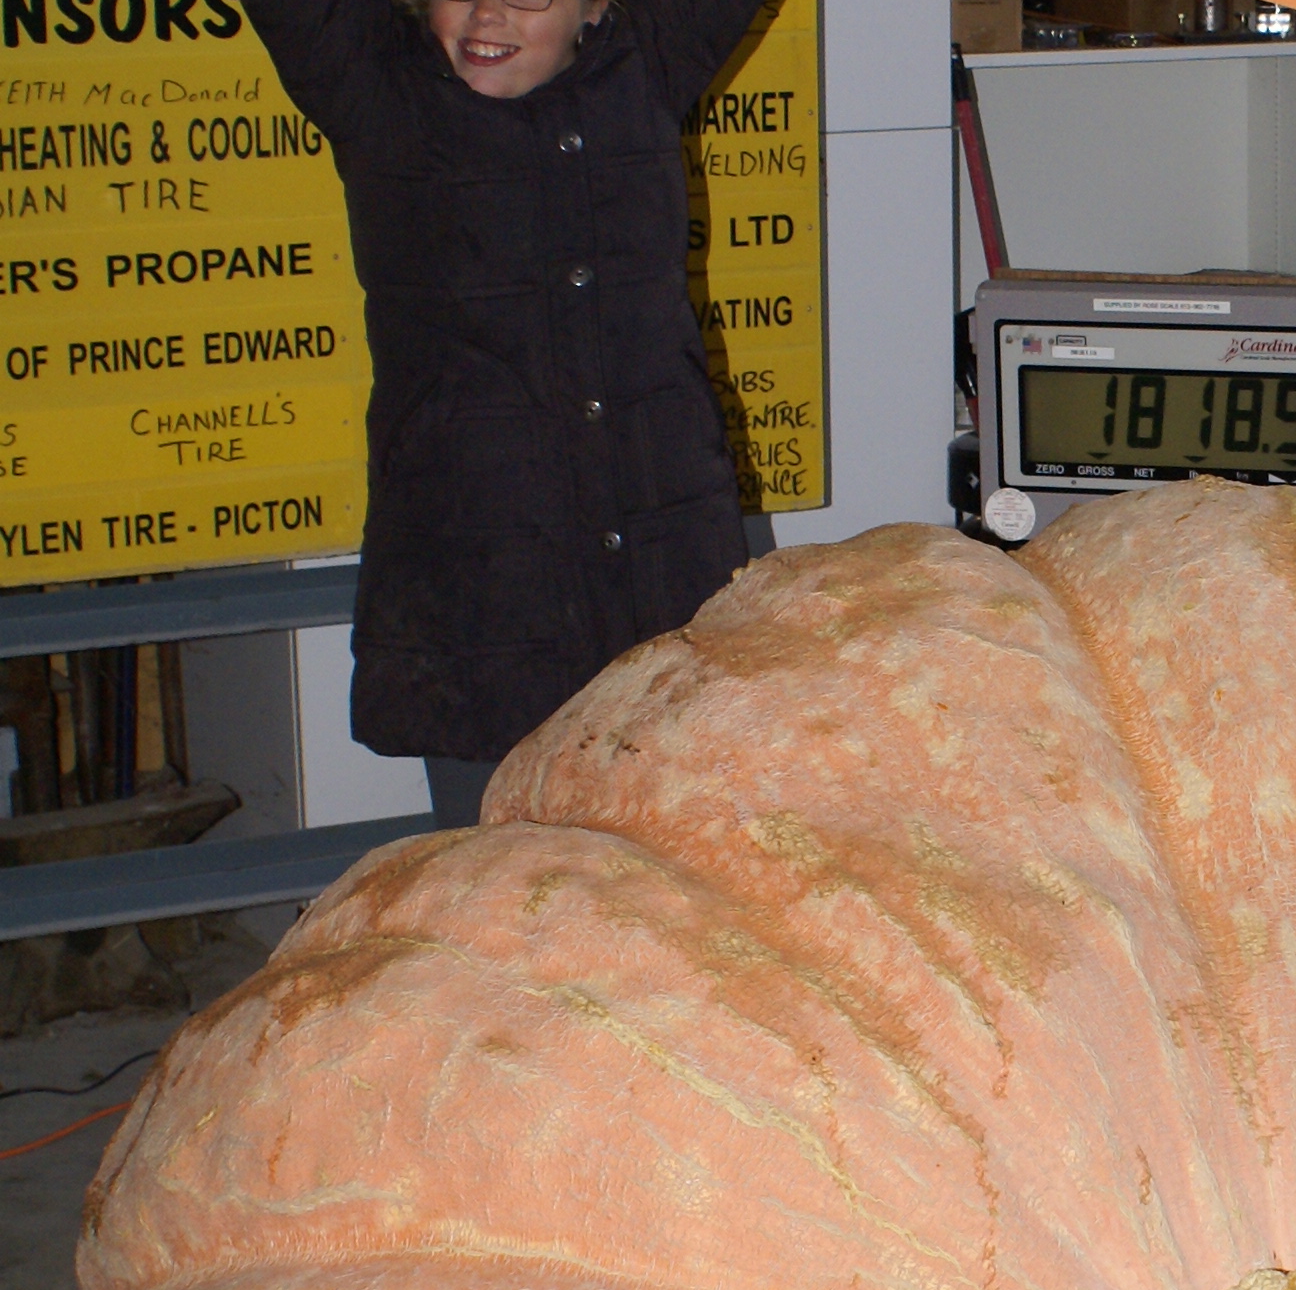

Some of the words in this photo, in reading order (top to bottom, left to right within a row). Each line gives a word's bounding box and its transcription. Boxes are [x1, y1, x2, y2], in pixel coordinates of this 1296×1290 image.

[0, 121, 132, 172] HEATING
[150, 119, 171, 164] &
[187, 113, 322, 162] COOLING
[685, 142, 807, 179] WELDING
[108, 177, 210, 213] TIRE
[729, 214, 795, 248] LTD
[0, 258, 79, 295] R'S
[106, 242, 314, 288] PROPANE
[7, 345, 48, 381] OF
[69, 334, 185, 376] PRINCE
[204, 325, 336, 366] EDWARD
[158, 438, 247, 466] TIRE
[1036, 463, 1065, 476] ZERO
[1077, 464, 1115, 478] GROSS
[1134, 468, 1156, 479] NET
[102, 510, 177, 549] TIRE
[213, 496, 323, 539] PICTON
